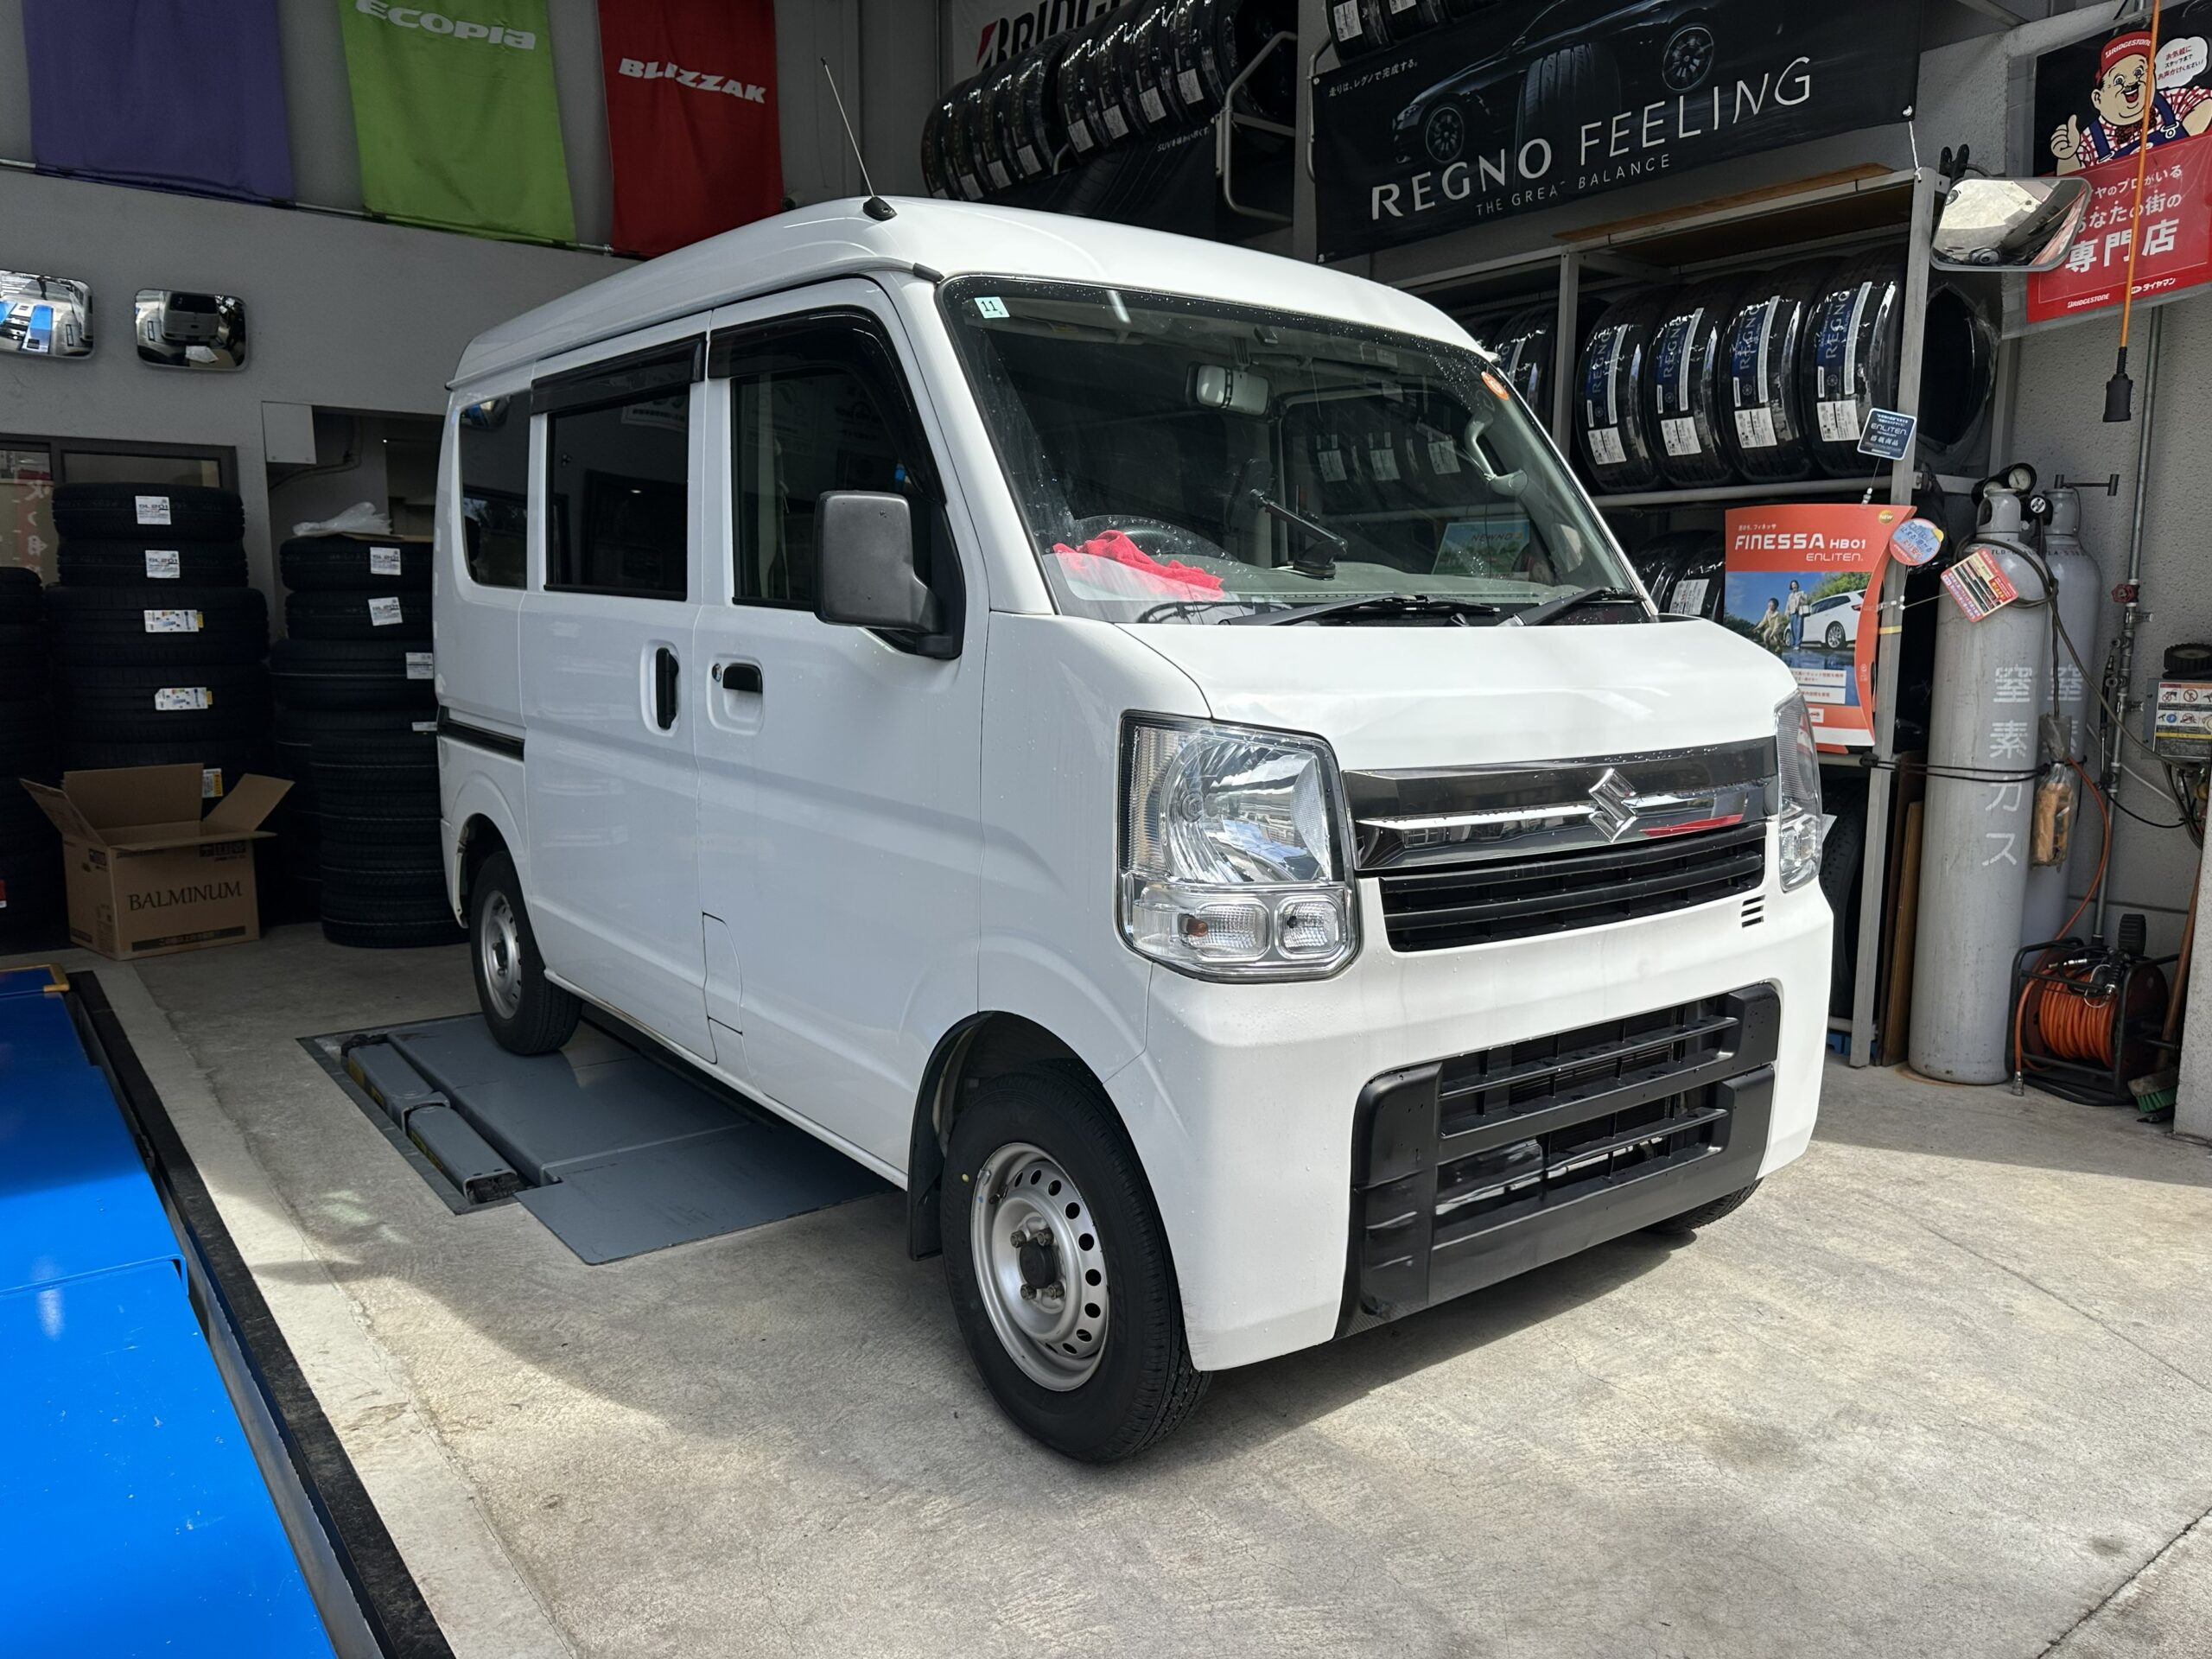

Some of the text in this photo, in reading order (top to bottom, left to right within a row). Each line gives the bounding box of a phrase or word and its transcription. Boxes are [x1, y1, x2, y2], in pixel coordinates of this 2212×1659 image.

[619, 57, 766, 104] BLIZZAK
[1370, 55, 1812, 221] REGNO FEELING
[1476, 200, 1503, 217] THE
[1578, 153, 1671, 190] BALANCE
[2091, 164, 2183, 200] ヤのプロがいる
[2065, 219, 2179, 273] 専門店
[981, 300, 999, 312] 11
[1826, 289, 1851, 359] REGNO
[2067, 293, 2111, 308] BRIDGESTONE
[1592, 329, 1613, 394] REGNO
[1662, 318, 1685, 378] REGNO
[1735, 533, 1866, 550] FINESSA HB01
[127, 880, 243, 912] BALMINUM
